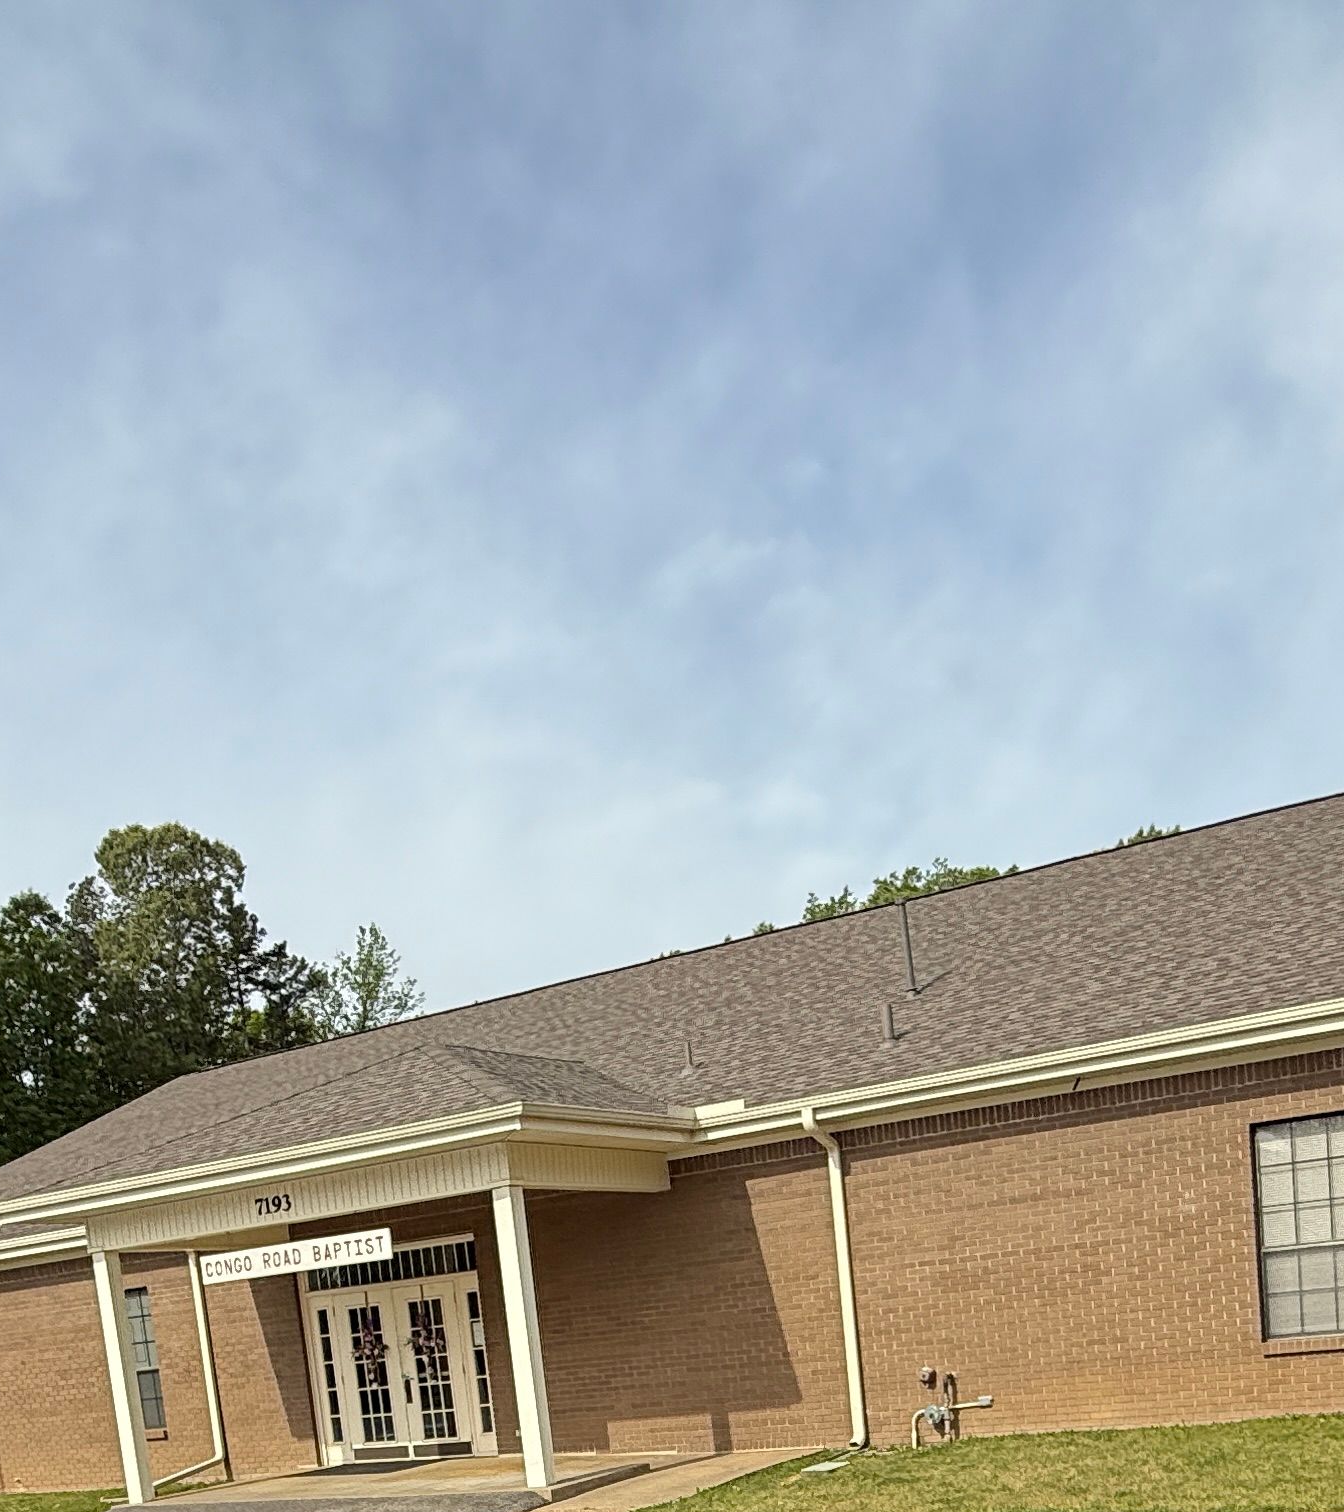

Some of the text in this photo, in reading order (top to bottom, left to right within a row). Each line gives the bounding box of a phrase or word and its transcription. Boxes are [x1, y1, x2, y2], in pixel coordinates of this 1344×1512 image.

[255, 1194, 292, 1216] 7193
[205, 1236, 384, 1278] CONGO ROAD BAPTIST
